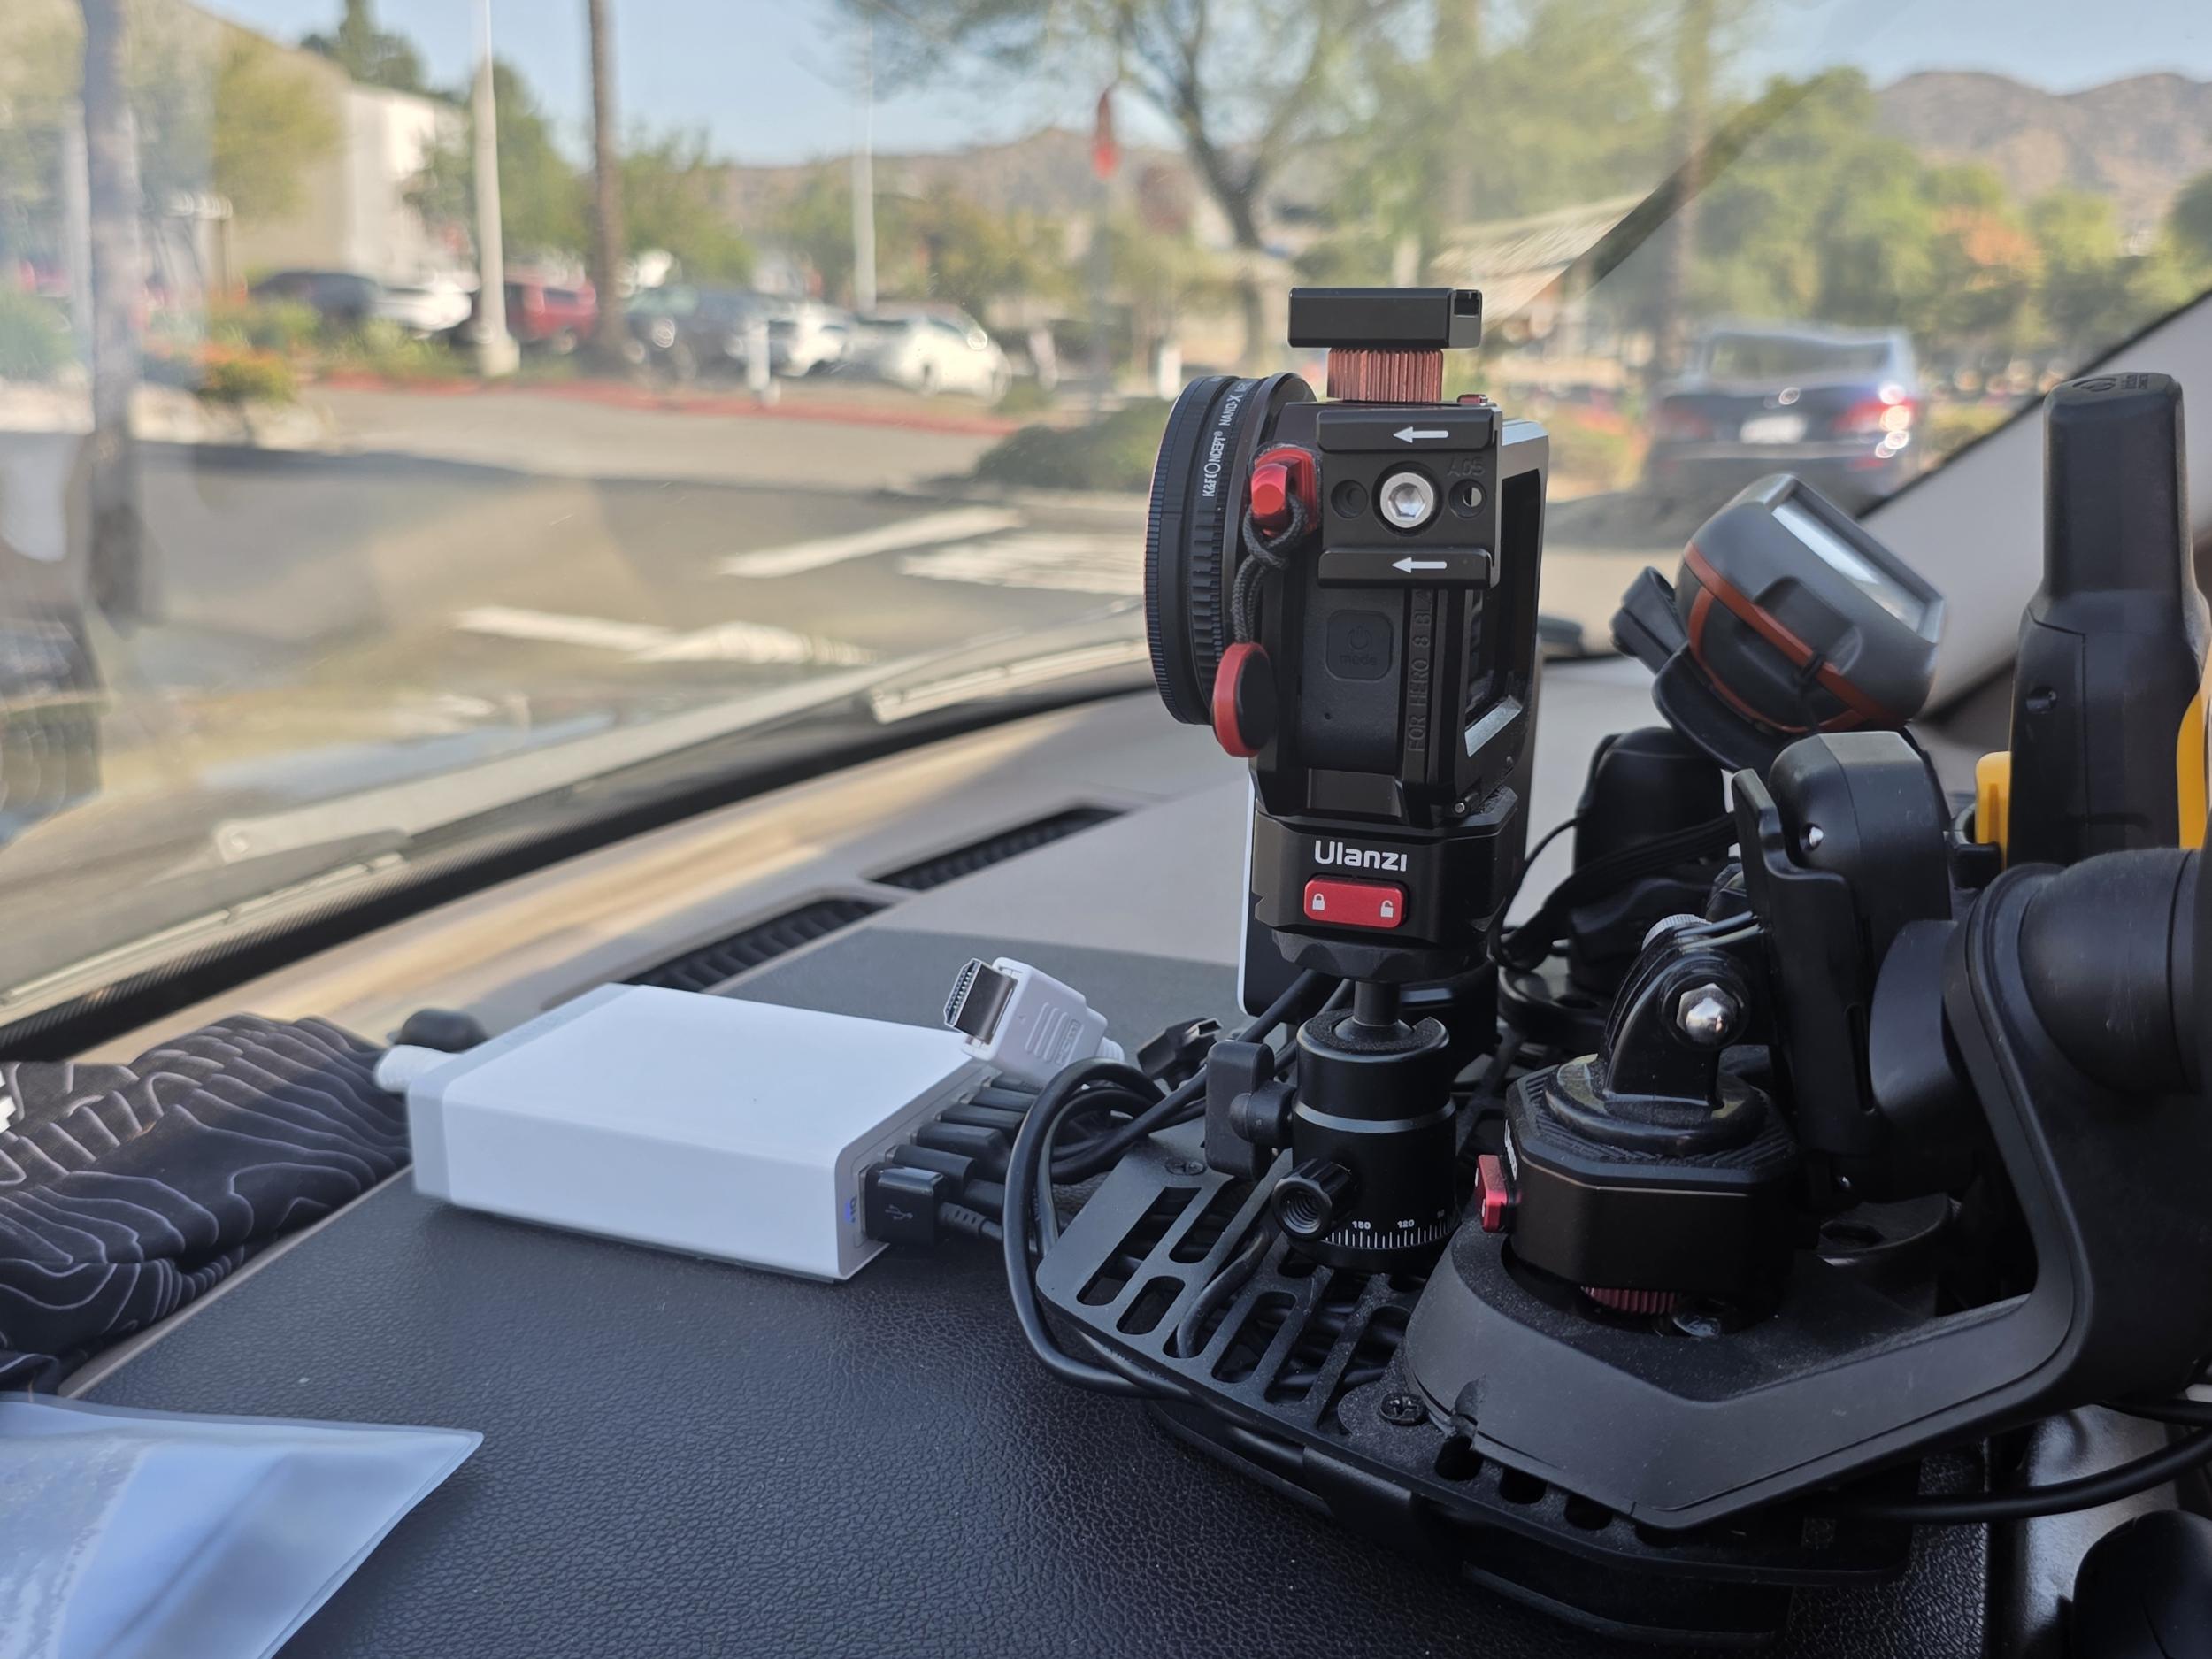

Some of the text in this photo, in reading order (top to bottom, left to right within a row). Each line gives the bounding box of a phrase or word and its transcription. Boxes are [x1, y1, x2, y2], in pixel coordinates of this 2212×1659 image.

[1411, 635, 1431, 649] 8
[1409, 659, 1430, 707] HERO
[1408, 715, 1427, 752] FOR
[1314, 839, 1409, 872] Ulanzi
[1396, 1218, 1415, 1229] 120
